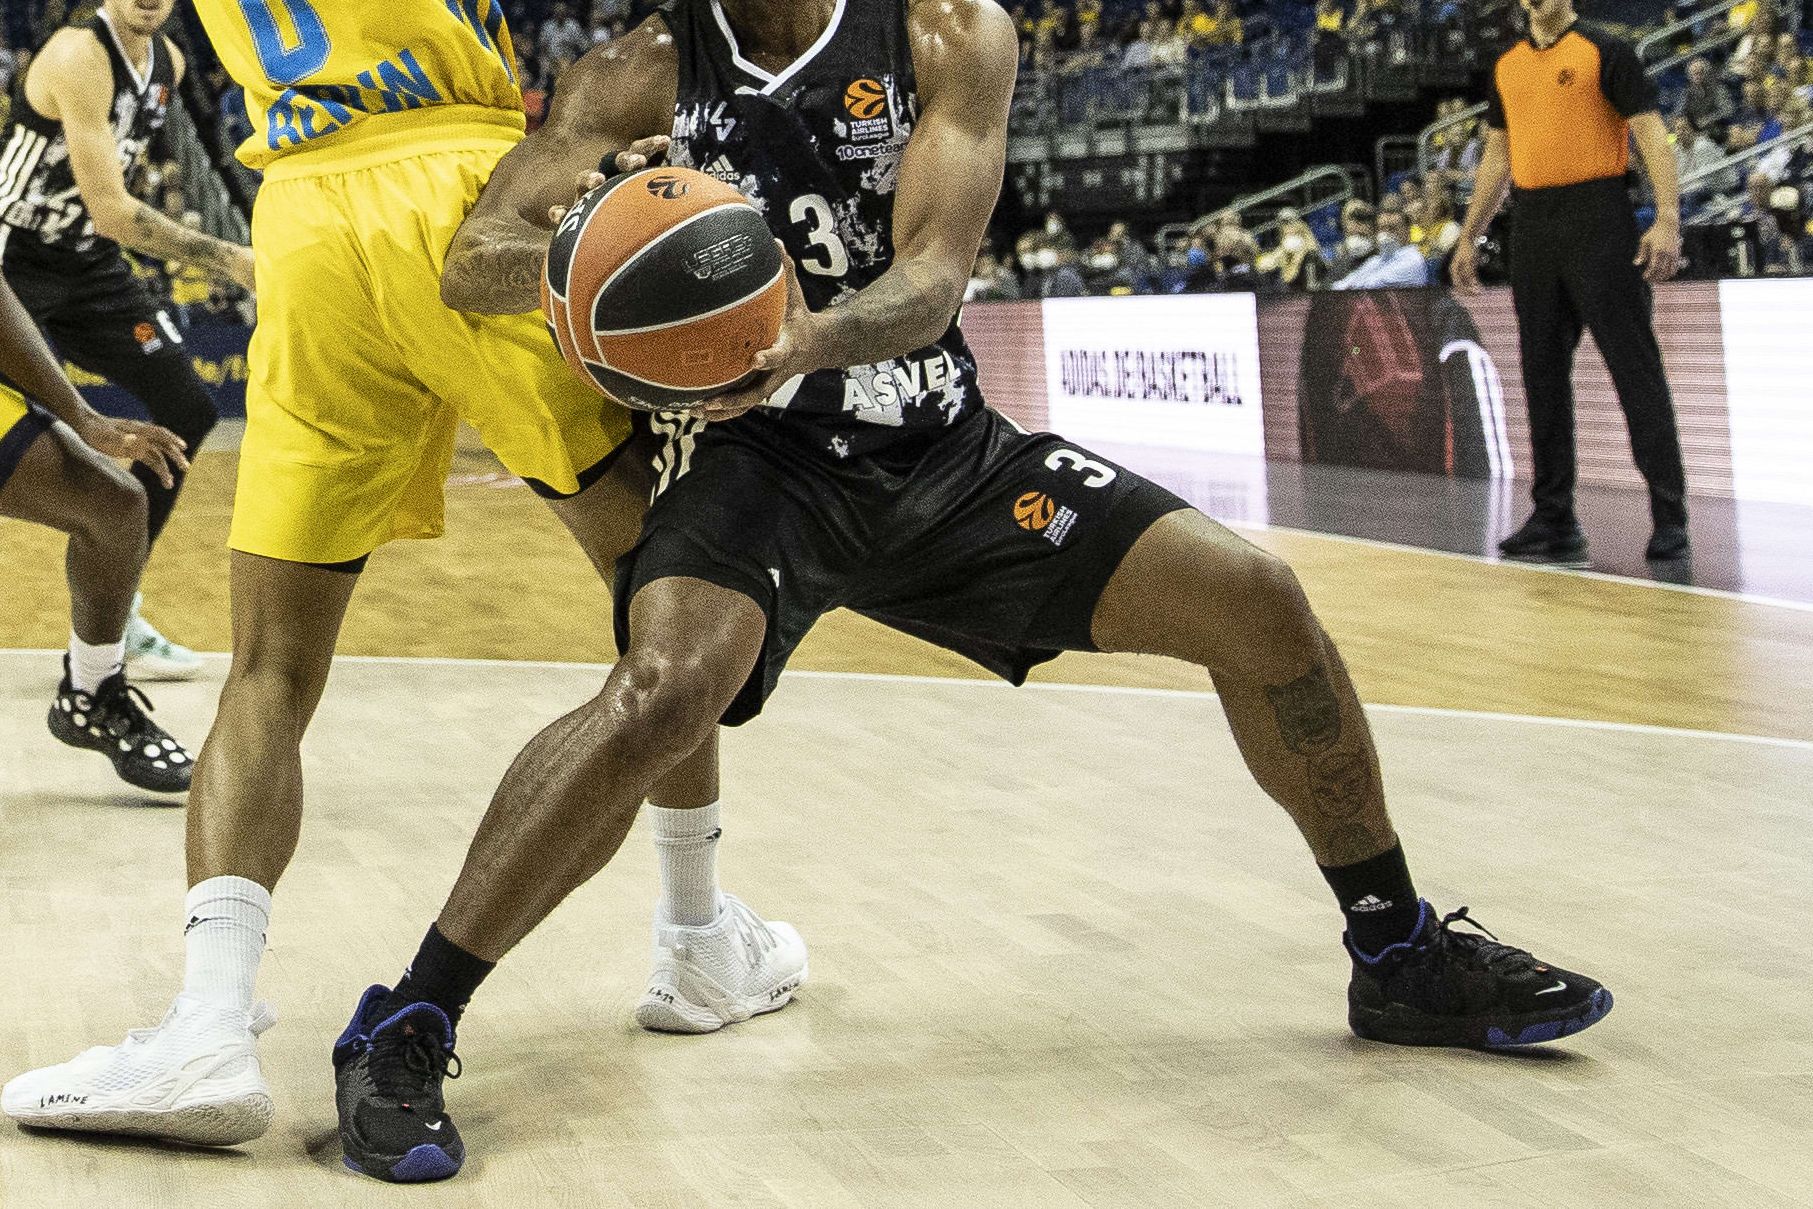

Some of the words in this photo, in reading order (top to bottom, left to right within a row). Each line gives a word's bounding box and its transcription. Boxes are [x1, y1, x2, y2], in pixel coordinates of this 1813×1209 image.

[850, 117, 888, 129] TURKISH
[851, 125, 889, 135] AIRLINES
[708, 170, 741, 181] didas
[789, 193, 850, 278] 3
[842, 350, 962, 412] ASVEL
[1044, 448, 1118, 489] 3
[1043, 505, 1067, 539] TURKISH
[40, 1093, 89, 1109] LAMINE
